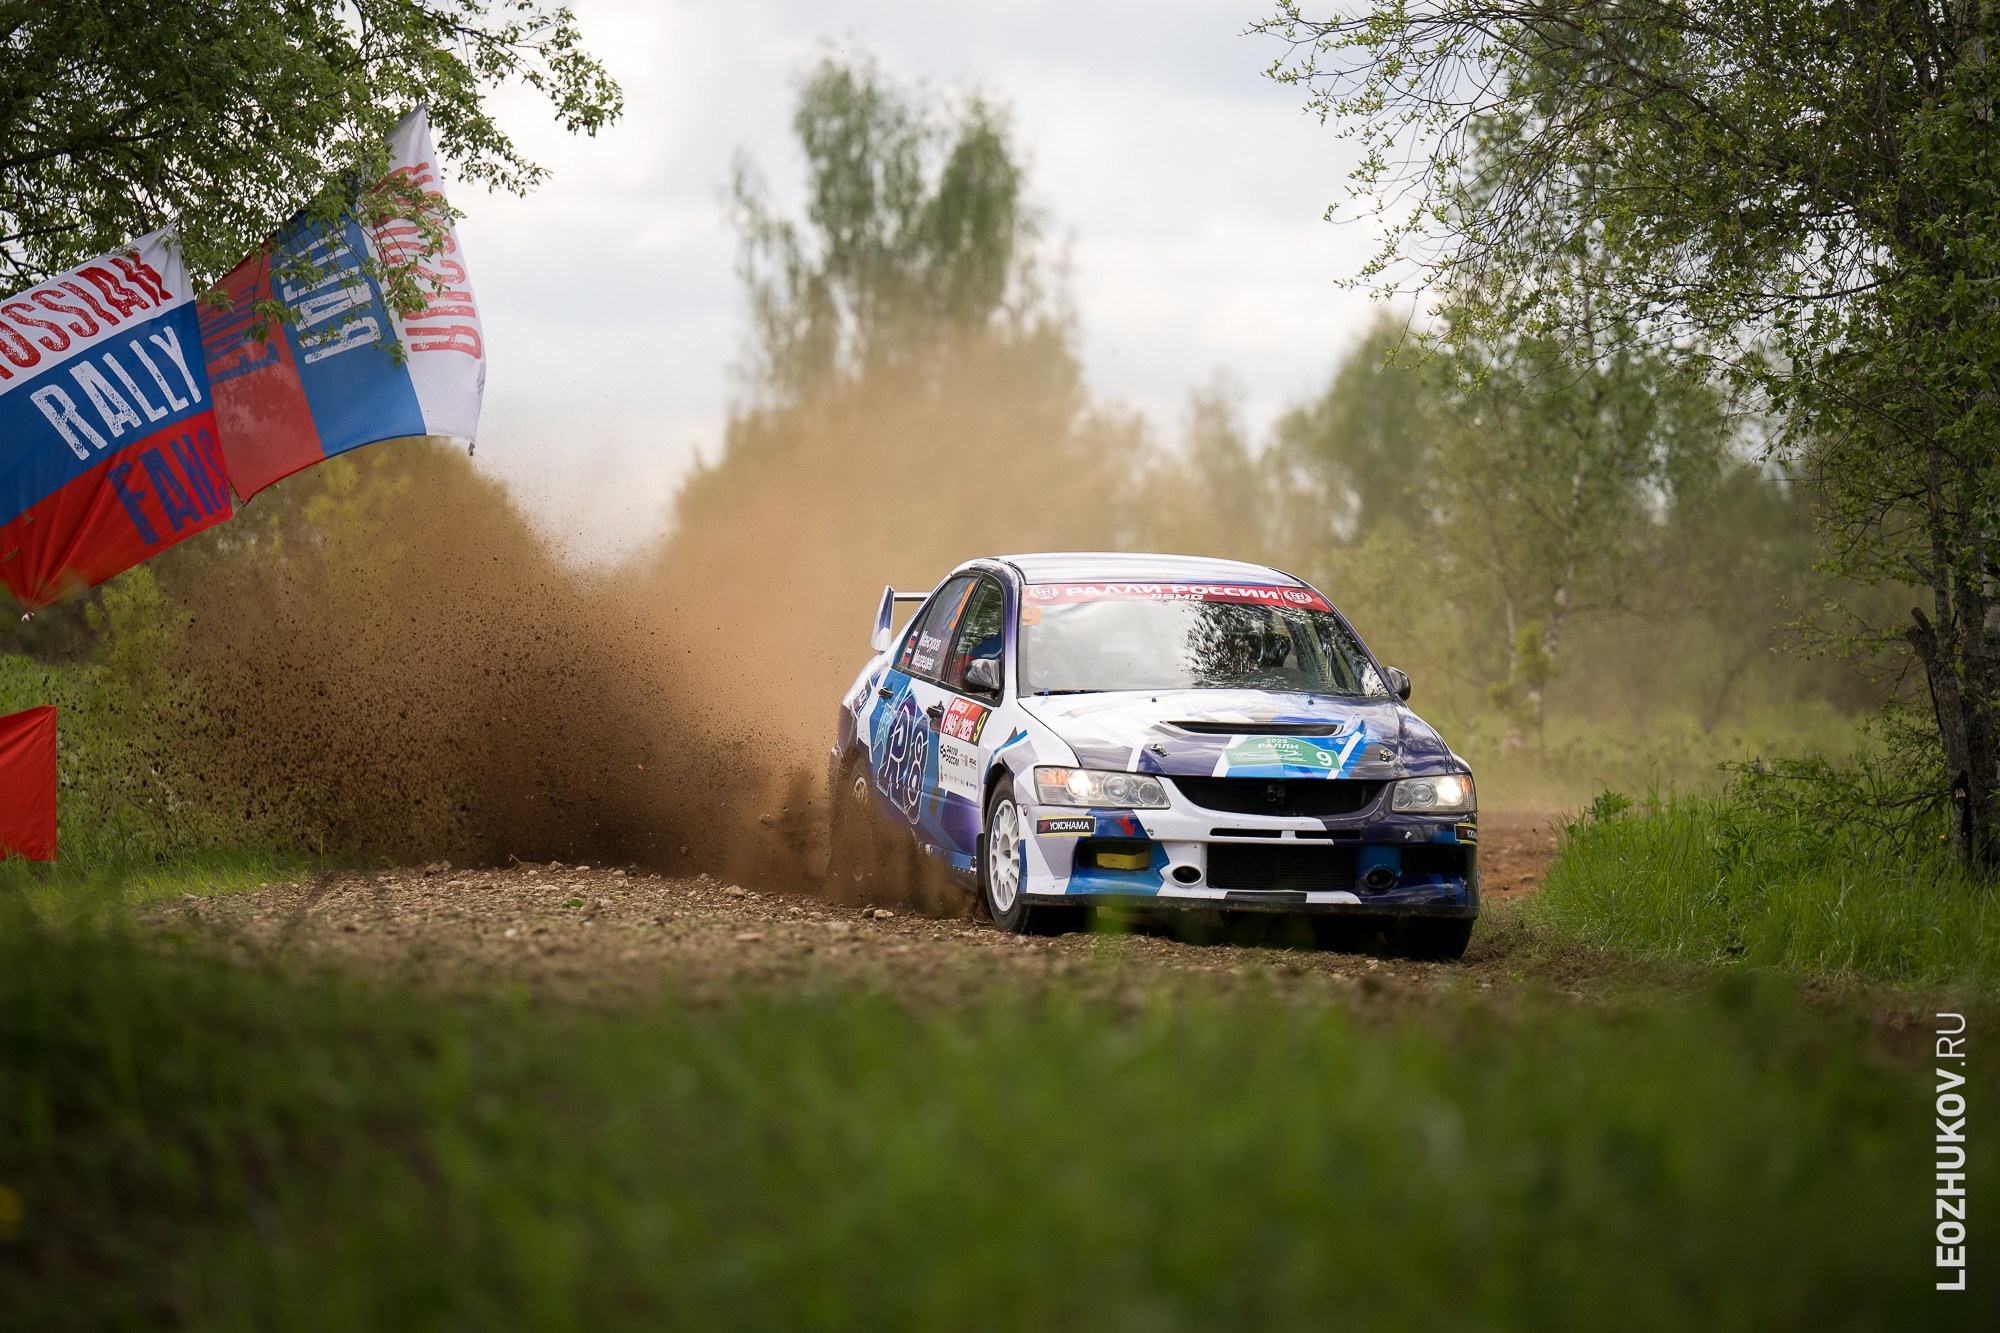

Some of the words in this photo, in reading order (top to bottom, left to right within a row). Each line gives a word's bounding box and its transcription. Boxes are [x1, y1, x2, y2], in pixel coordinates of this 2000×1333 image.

[0, 252, 173, 380] USSIAN
[30, 325, 202, 461] RALLY
[106, 428, 231, 545] FANS
[1065, 585, 1163, 597] РАЛЛИ
[1170, 585, 1280, 600] РОССИИ
[1022, 607, 1041, 626] 9
[943, 713, 959, 735] 1945
[957, 717, 975, 741] 2025
[973, 711, 987, 742] 9
[1315, 751, 1333, 766] 9
[1049, 821, 1090, 831] YOKOHAMA
